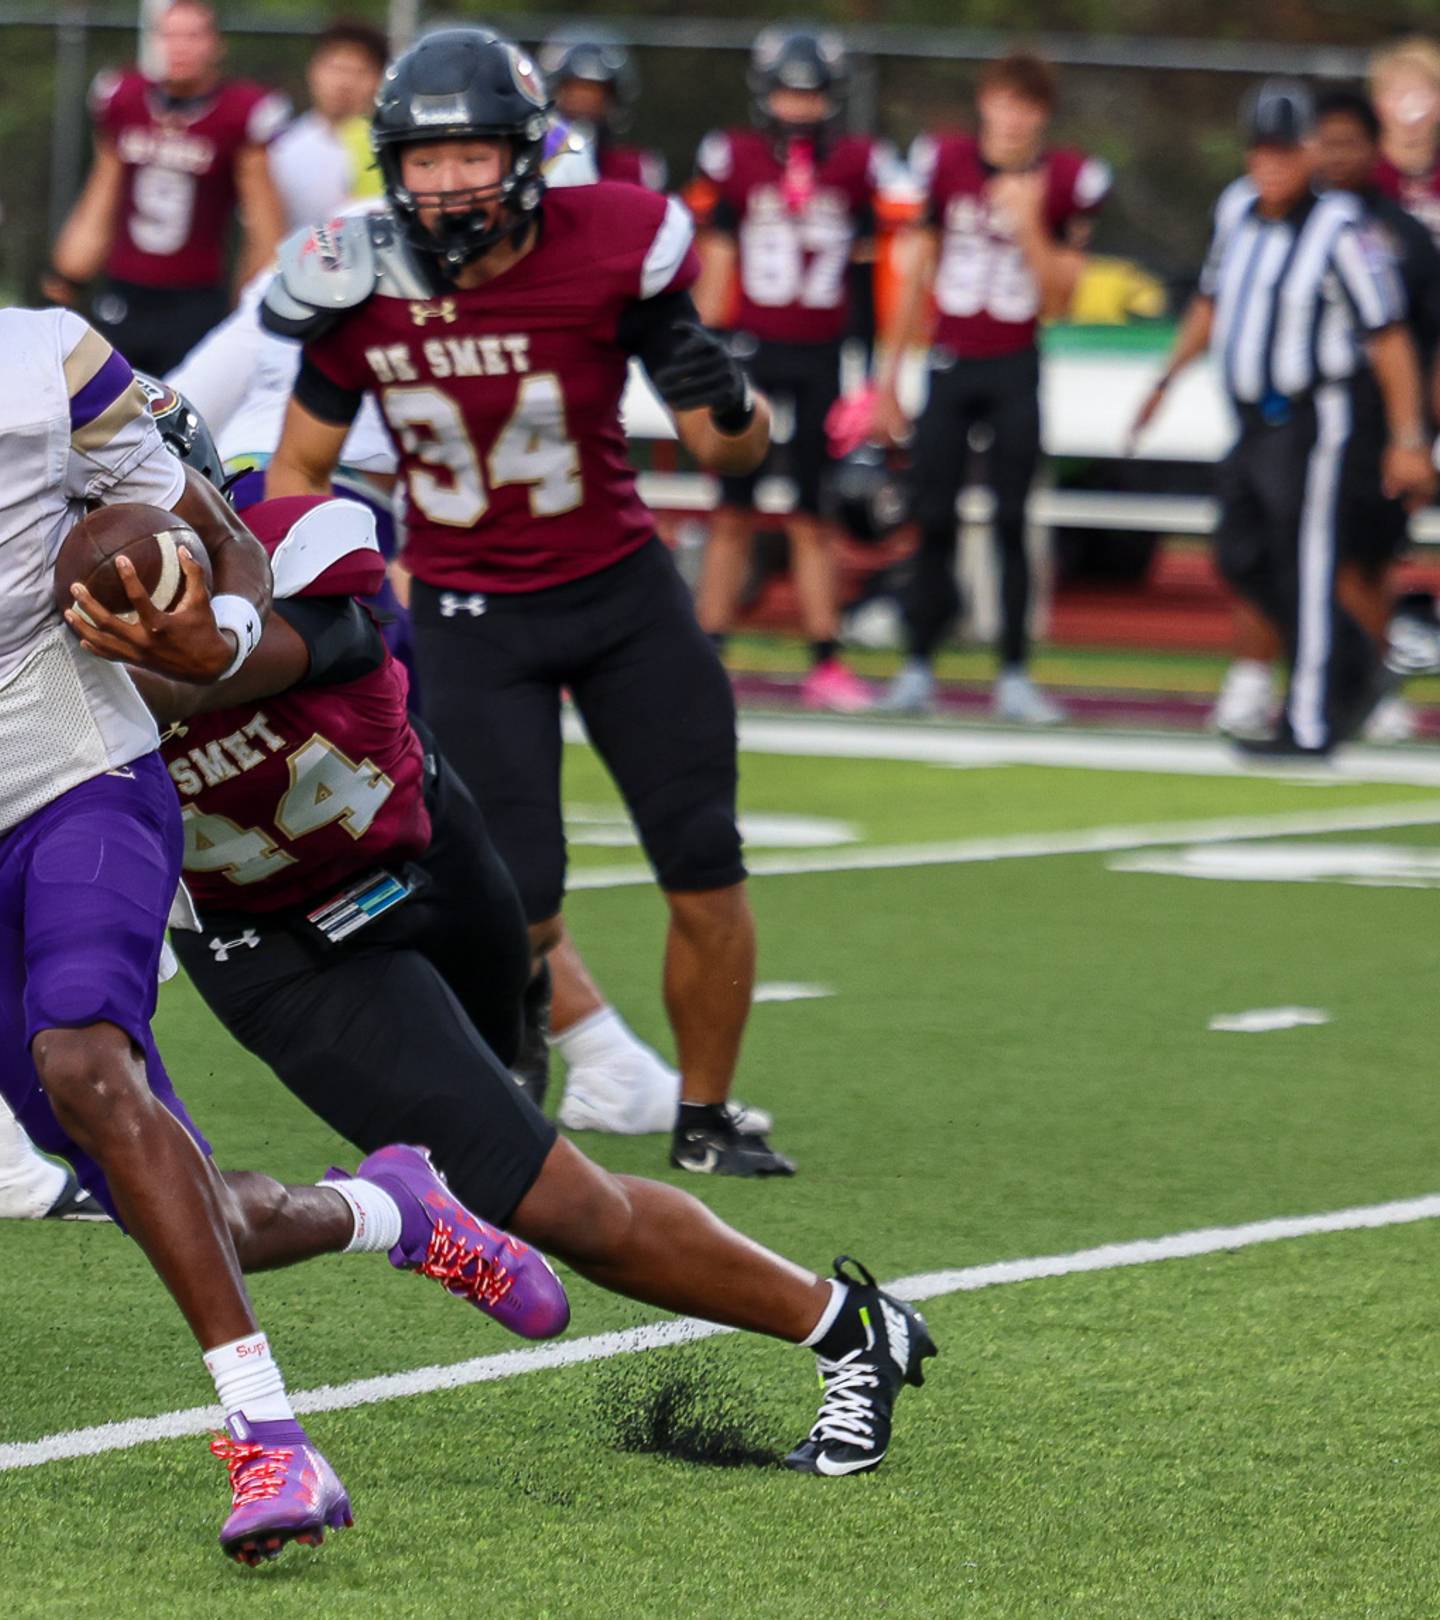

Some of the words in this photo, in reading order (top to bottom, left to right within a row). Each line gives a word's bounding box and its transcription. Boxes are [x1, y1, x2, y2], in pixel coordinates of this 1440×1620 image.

[365, 345, 419, 383] DE
[422, 335, 530, 379] SMET
[382, 372, 585, 529] 34
[168, 712, 287, 795] SMET
[181, 732, 396, 886] 44
